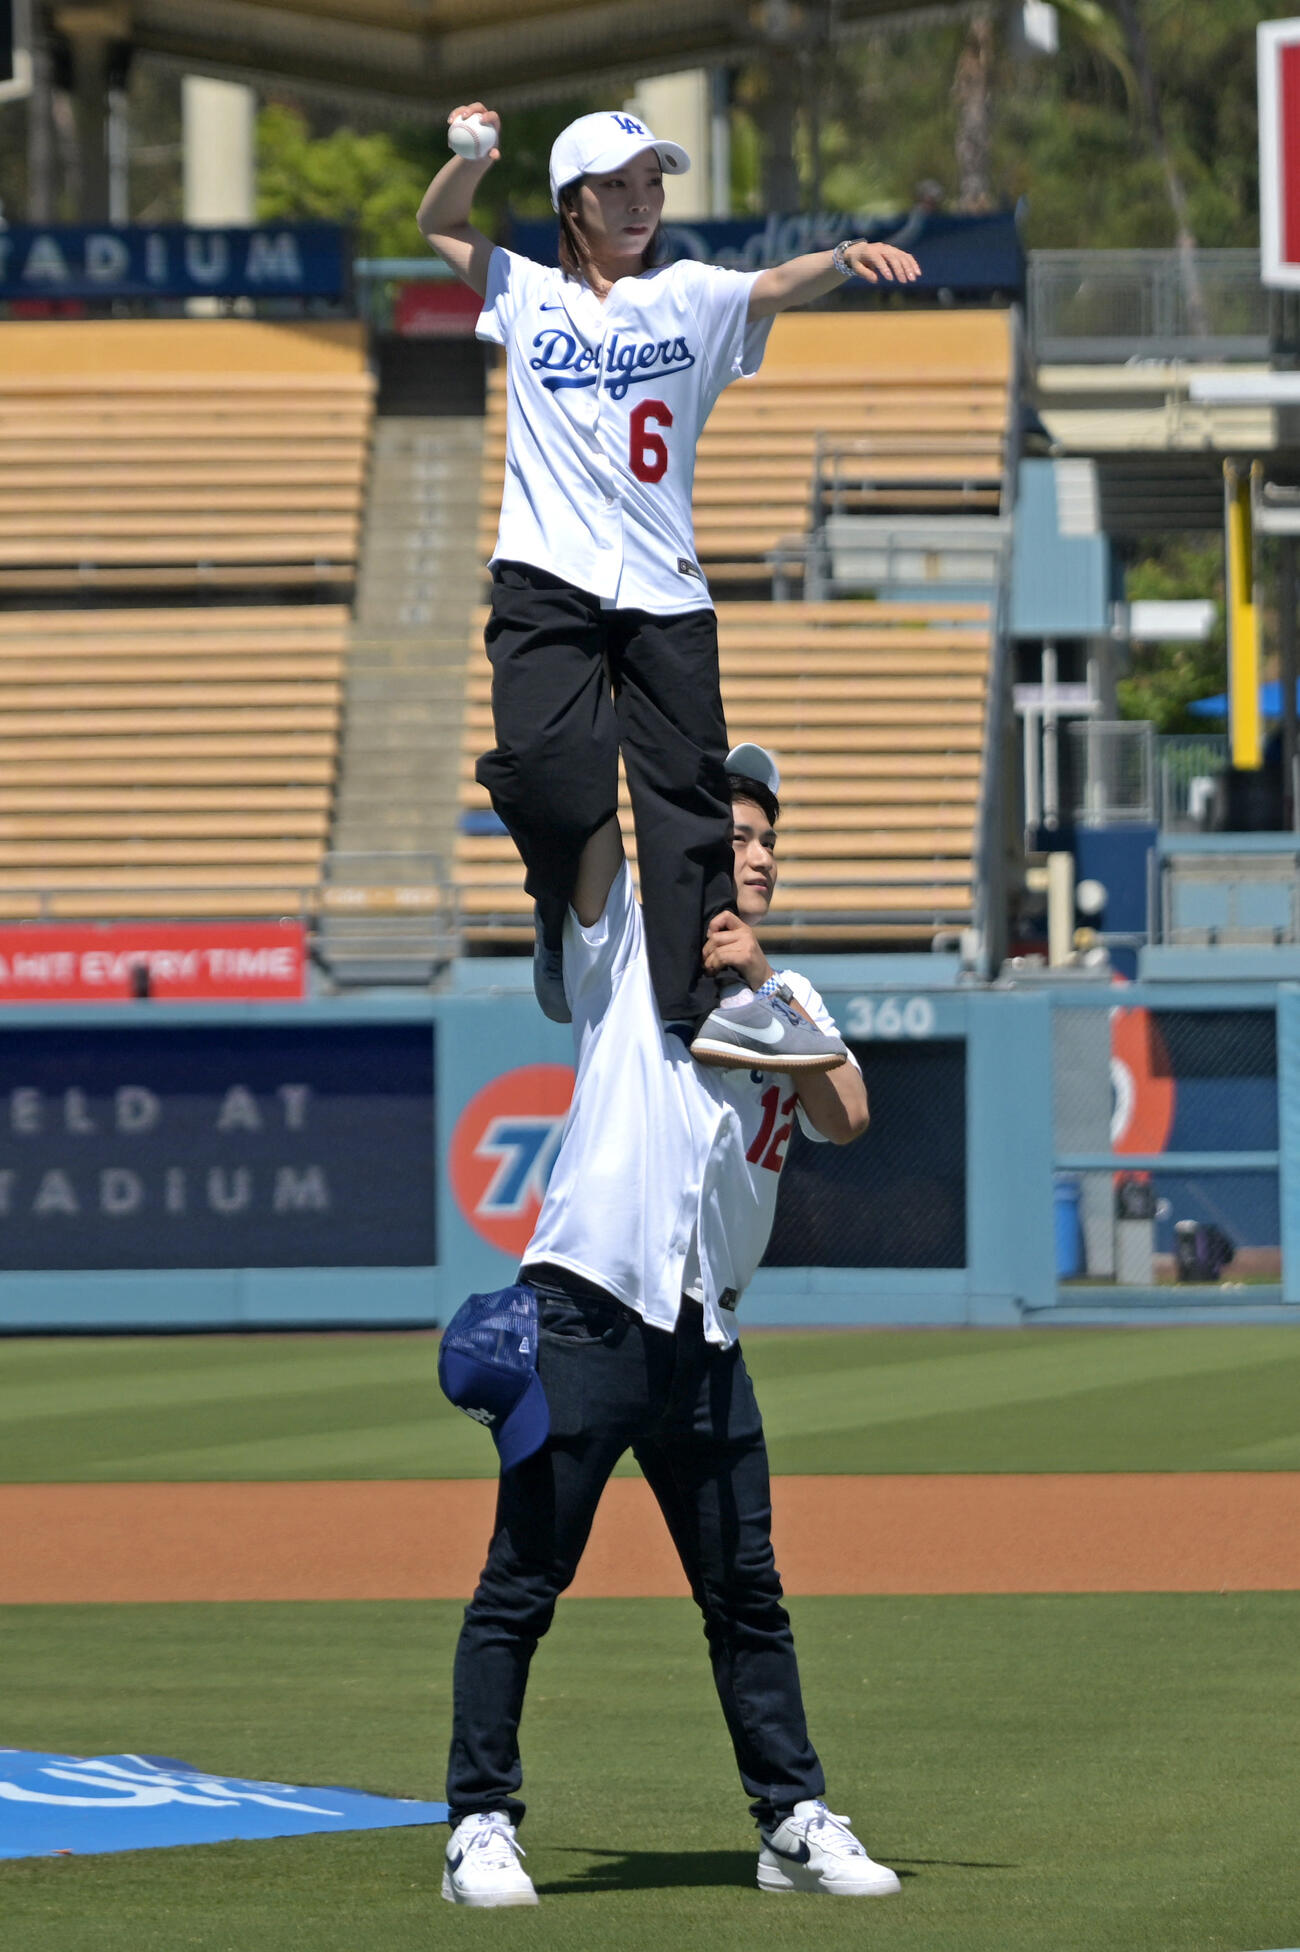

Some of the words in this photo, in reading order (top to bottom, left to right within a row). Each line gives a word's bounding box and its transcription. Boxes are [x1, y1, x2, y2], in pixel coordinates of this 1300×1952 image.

[610, 114, 645, 135] LA
[529, 328, 696, 400] Dodgers
[629, 398, 673, 484] 6
[204, 947, 295, 982] TIME
[845, 996, 936, 1038] 360
[10, 1085, 160, 1134] ELD
[216, 1083, 311, 1132] AT
[472, 1115, 570, 1216] 7
